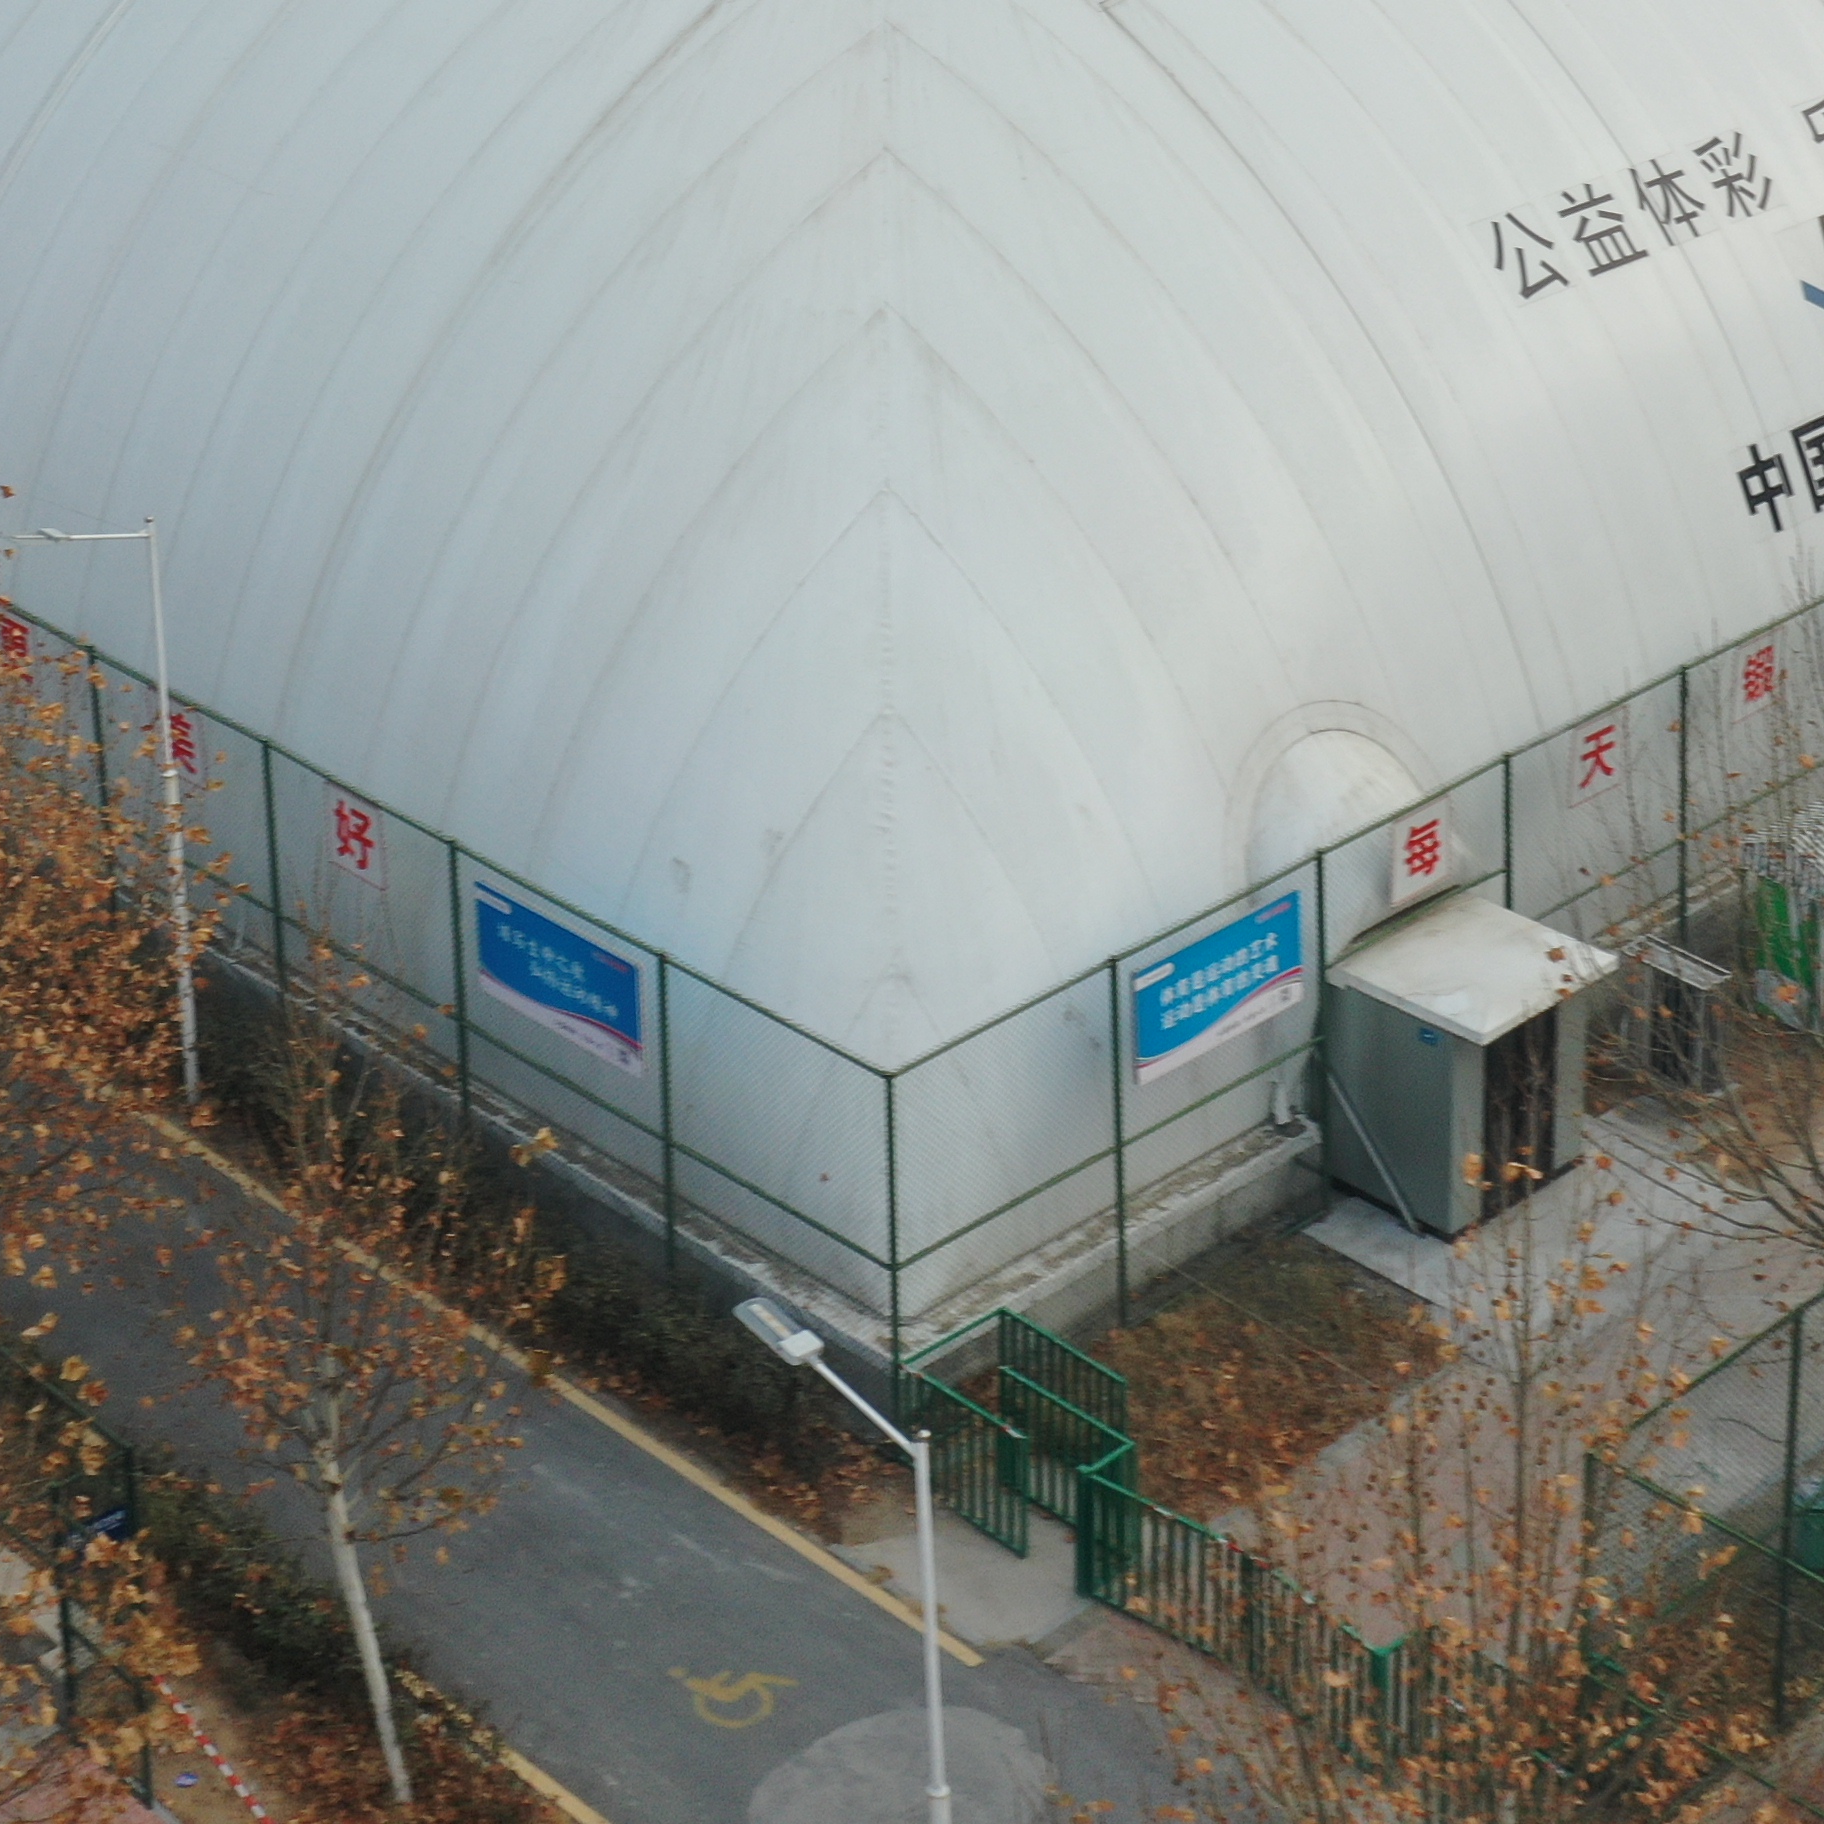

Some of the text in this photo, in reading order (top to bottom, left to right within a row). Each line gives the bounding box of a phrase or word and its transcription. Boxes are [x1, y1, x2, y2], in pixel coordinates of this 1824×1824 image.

[1490, 131, 1773, 300] 公益体彩
[333, 799, 377, 870] 好
[1404, 818, 1442, 876] 每
[1579, 724, 1616, 788] 天
